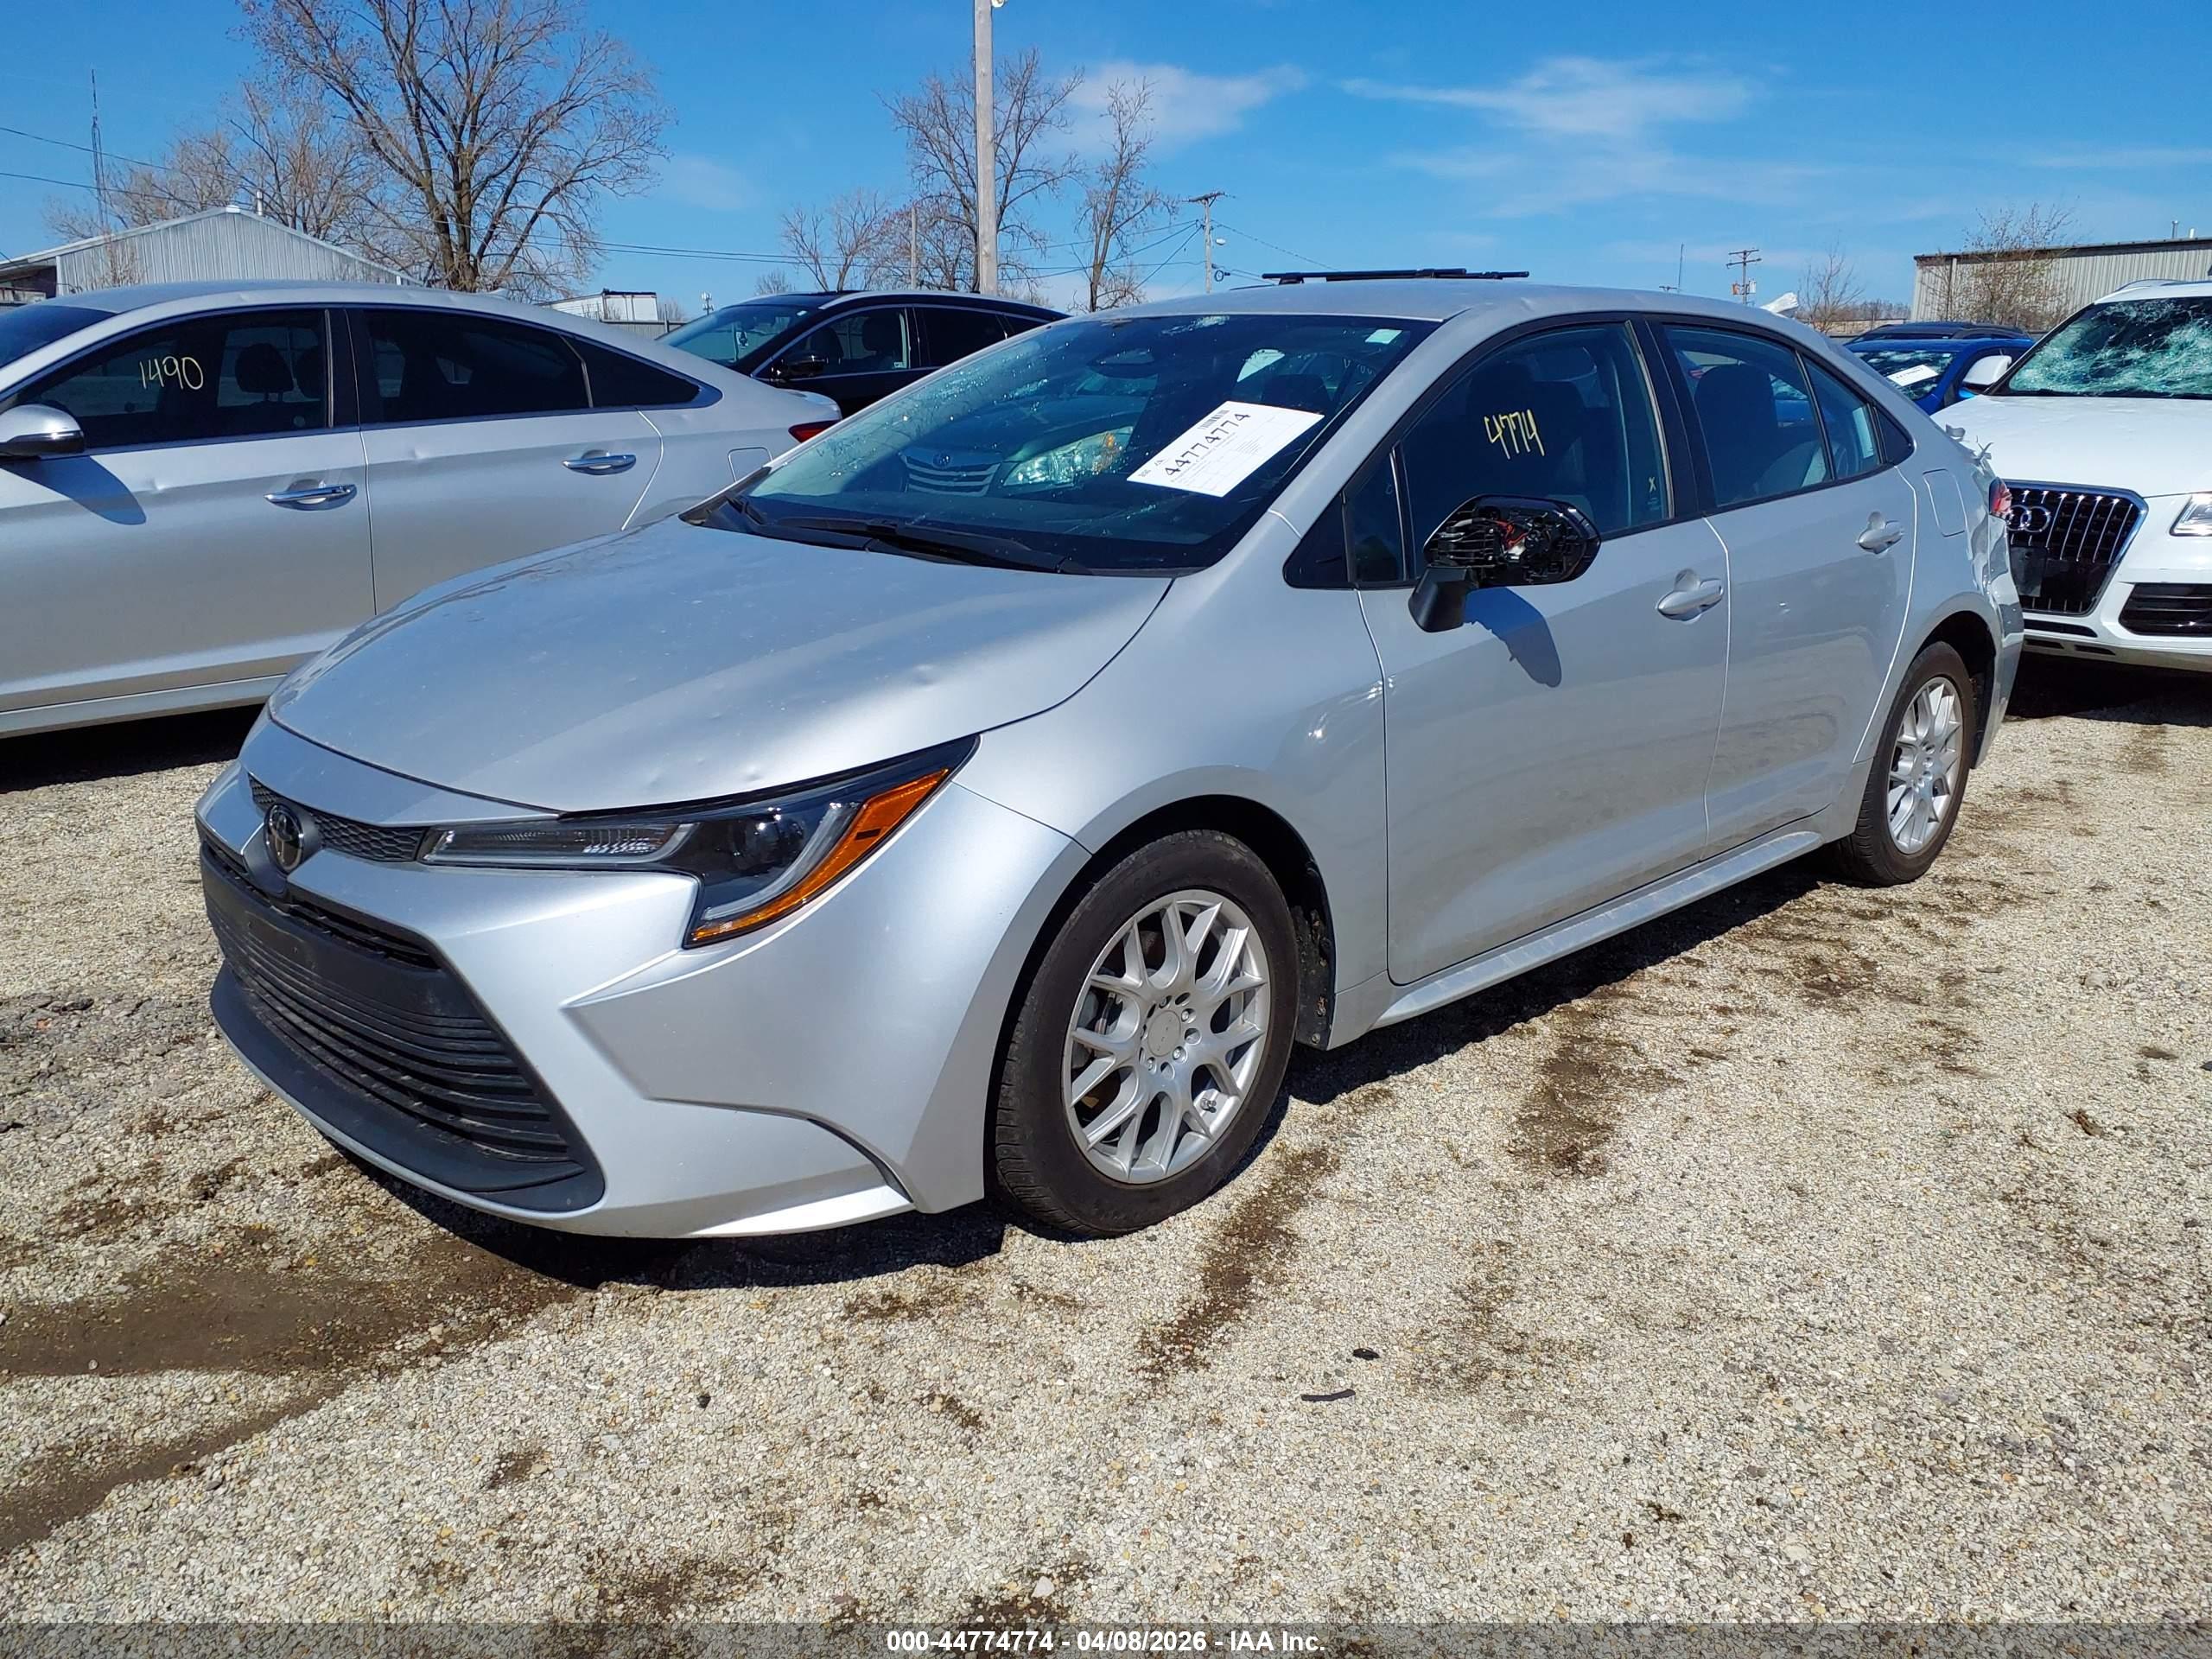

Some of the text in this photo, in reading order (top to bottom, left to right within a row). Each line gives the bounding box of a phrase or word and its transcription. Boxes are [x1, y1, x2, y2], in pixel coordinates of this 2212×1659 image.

[139, 356, 203, 390] 1490
[1165, 413, 1250, 476] 44774774
[1484, 409, 1544, 460] 4774
